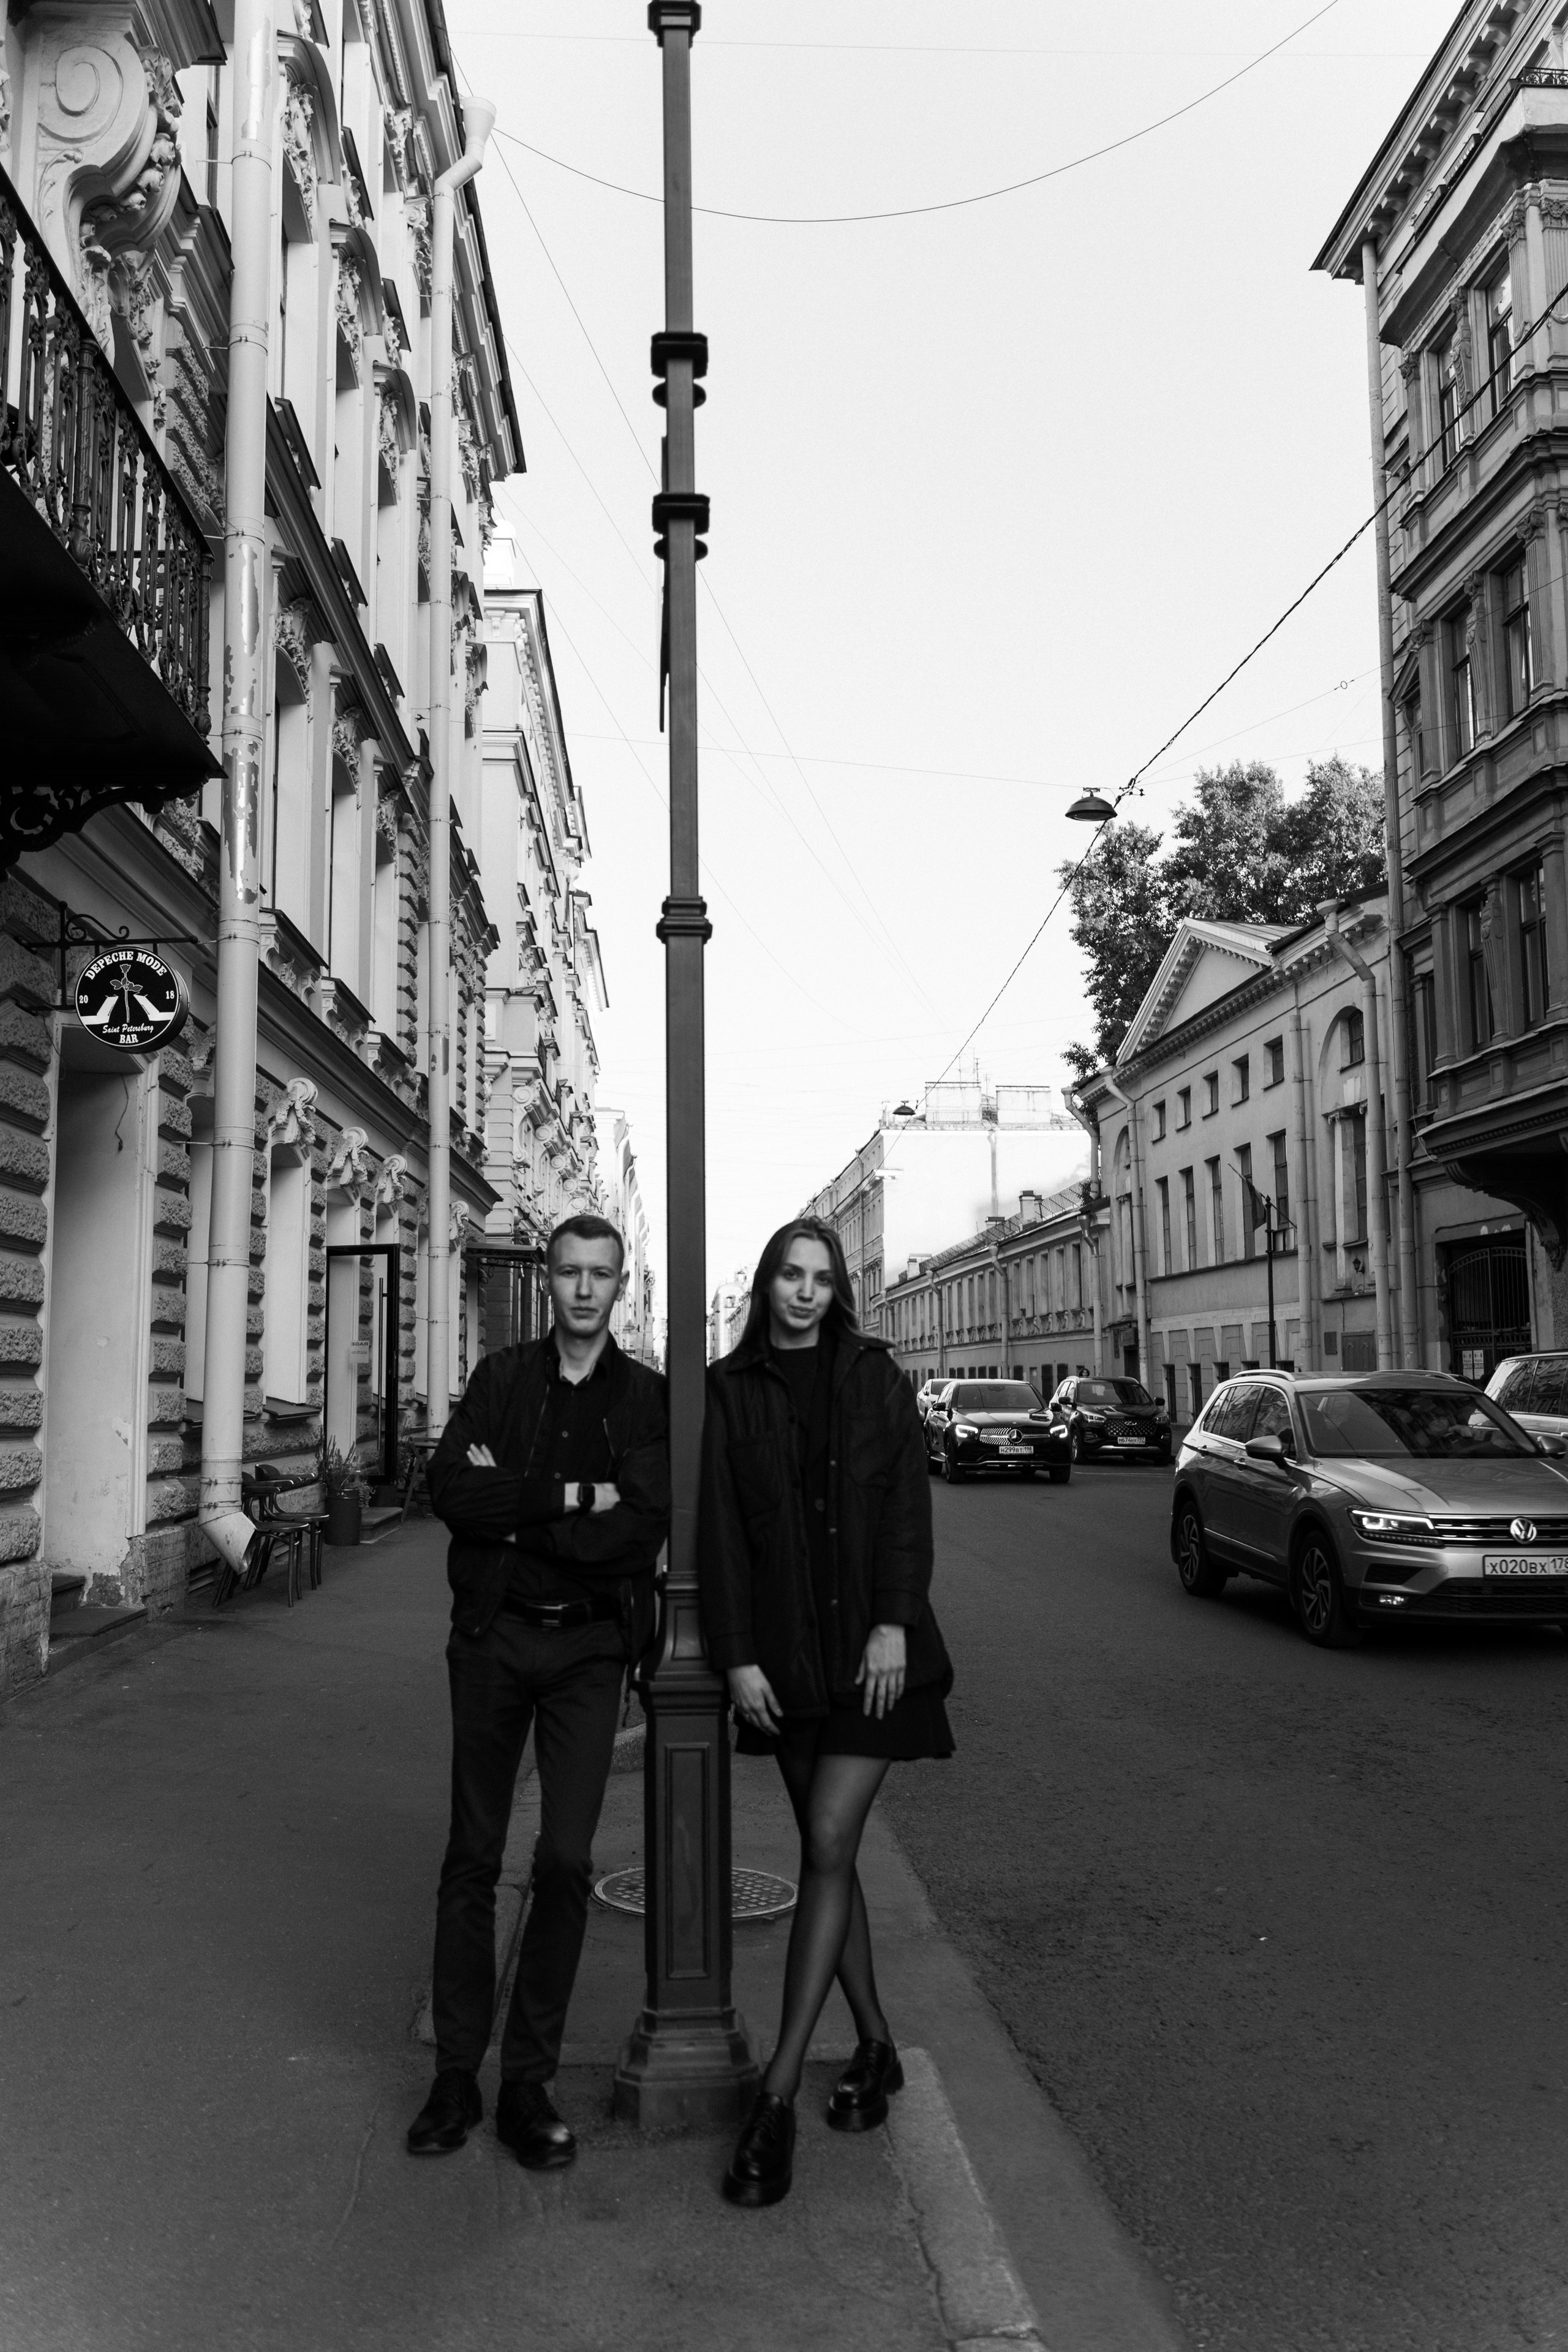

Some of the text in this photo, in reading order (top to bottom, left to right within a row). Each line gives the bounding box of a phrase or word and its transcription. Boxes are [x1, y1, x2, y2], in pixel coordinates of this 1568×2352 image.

[85, 951, 167, 980] DEPECHE MODE
[79, 995, 88, 1004] 20
[165, 990, 175, 999] 18
[102, 1023, 154, 1033] Saint Petersburg
[119, 1034, 138, 1044] BAR
